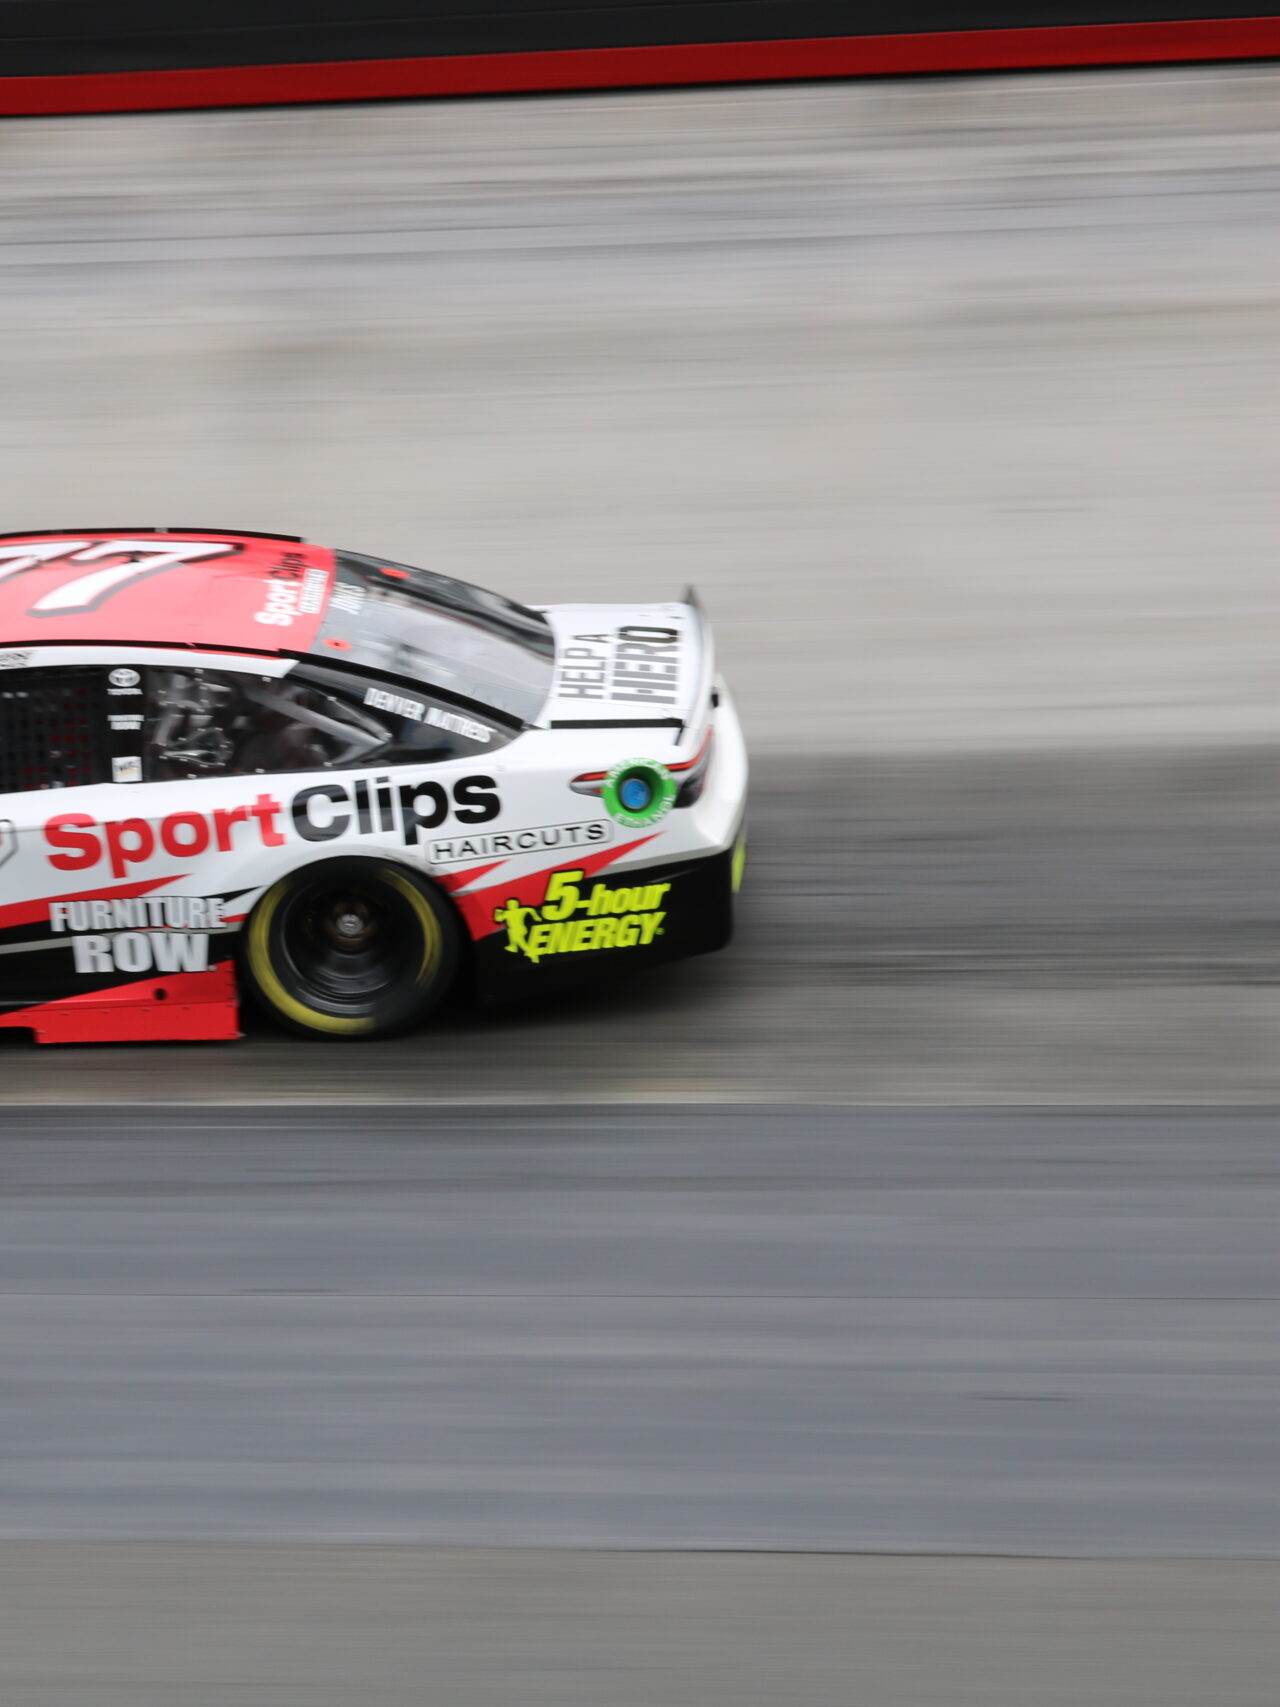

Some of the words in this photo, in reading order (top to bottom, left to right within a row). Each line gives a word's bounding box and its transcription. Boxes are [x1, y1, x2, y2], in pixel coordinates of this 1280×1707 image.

[570, 633, 610, 644] A
[558, 647, 606, 699] HELP
[610, 625, 679, 705] HERO
[363, 687, 426, 721] DENVER
[433, 823, 606, 861] HAIRCUTS
[48, 897, 228, 932] FURNITURE
[541, 870, 672, 921] 5-hour
[526, 911, 668, 957] ENERGY
